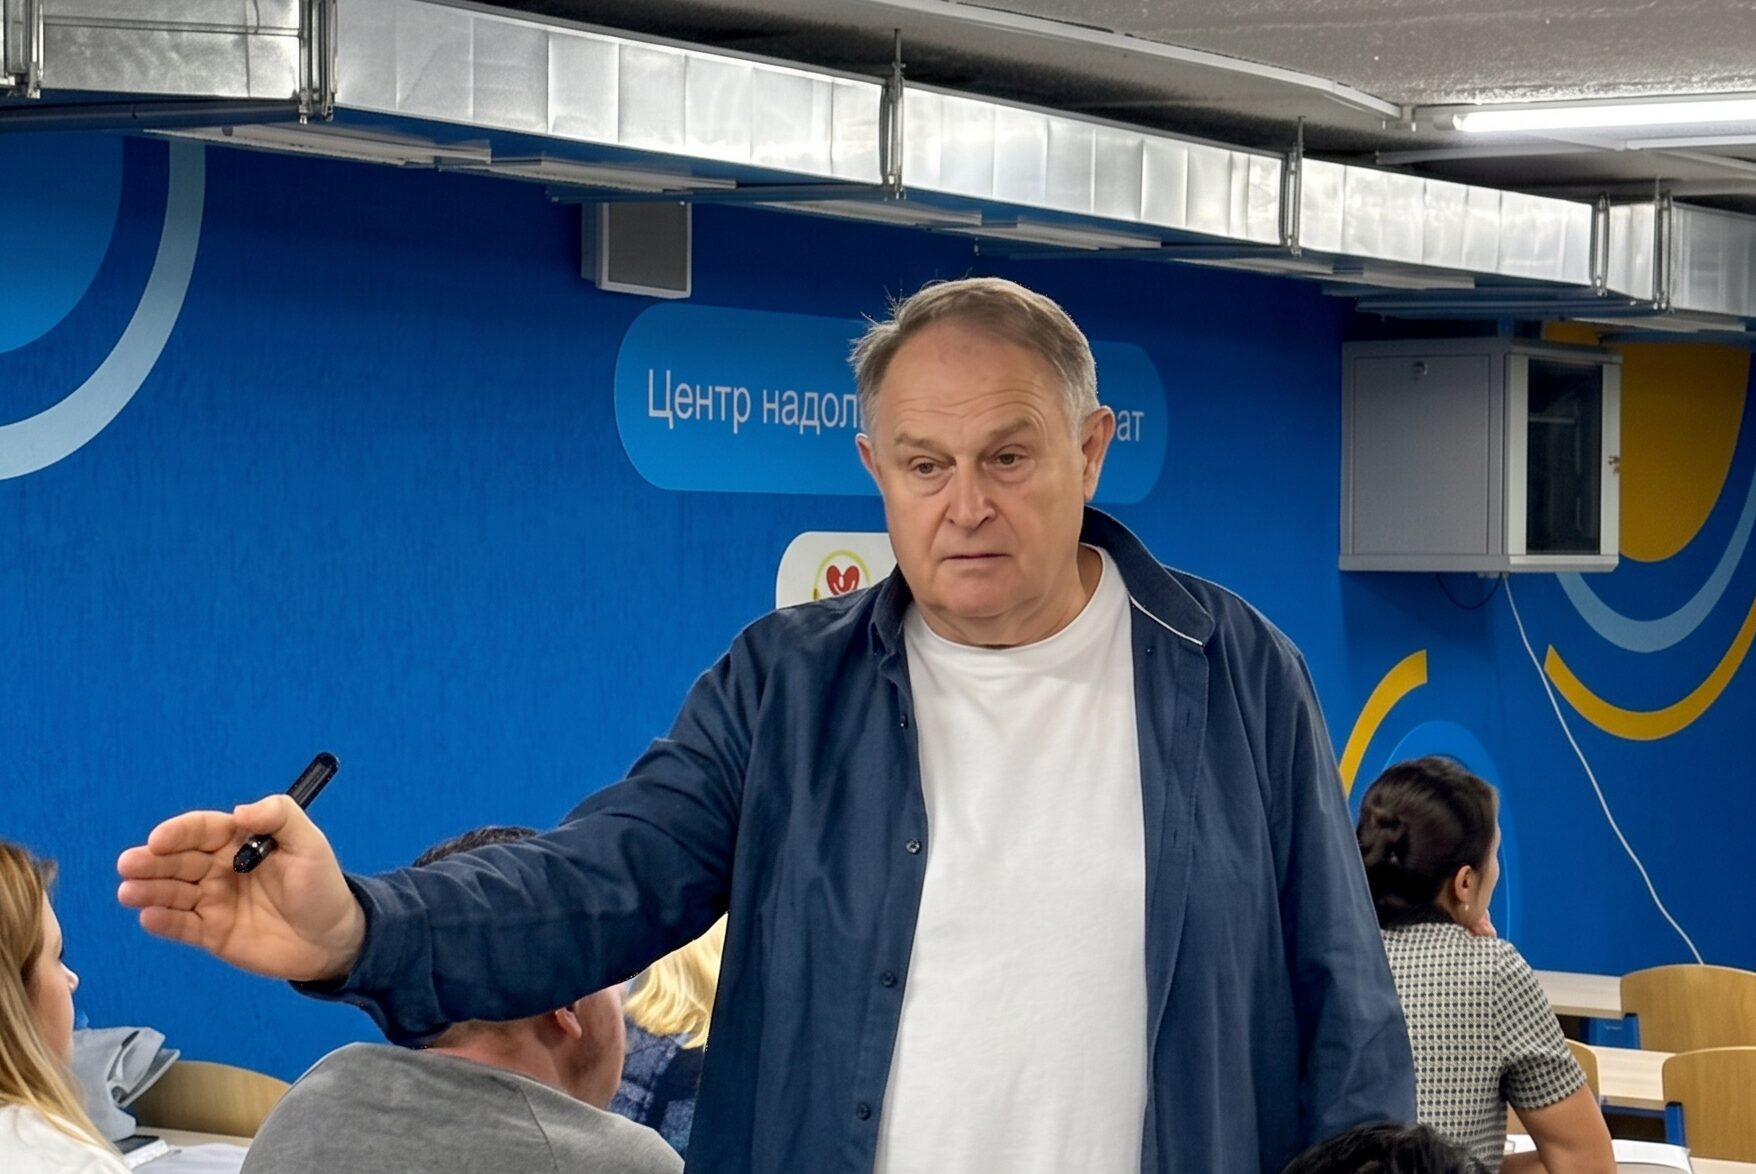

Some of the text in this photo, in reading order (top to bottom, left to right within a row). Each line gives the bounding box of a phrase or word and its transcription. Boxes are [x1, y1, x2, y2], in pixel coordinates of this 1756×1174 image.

[647, 369, 1145, 442] Центр надол ат
